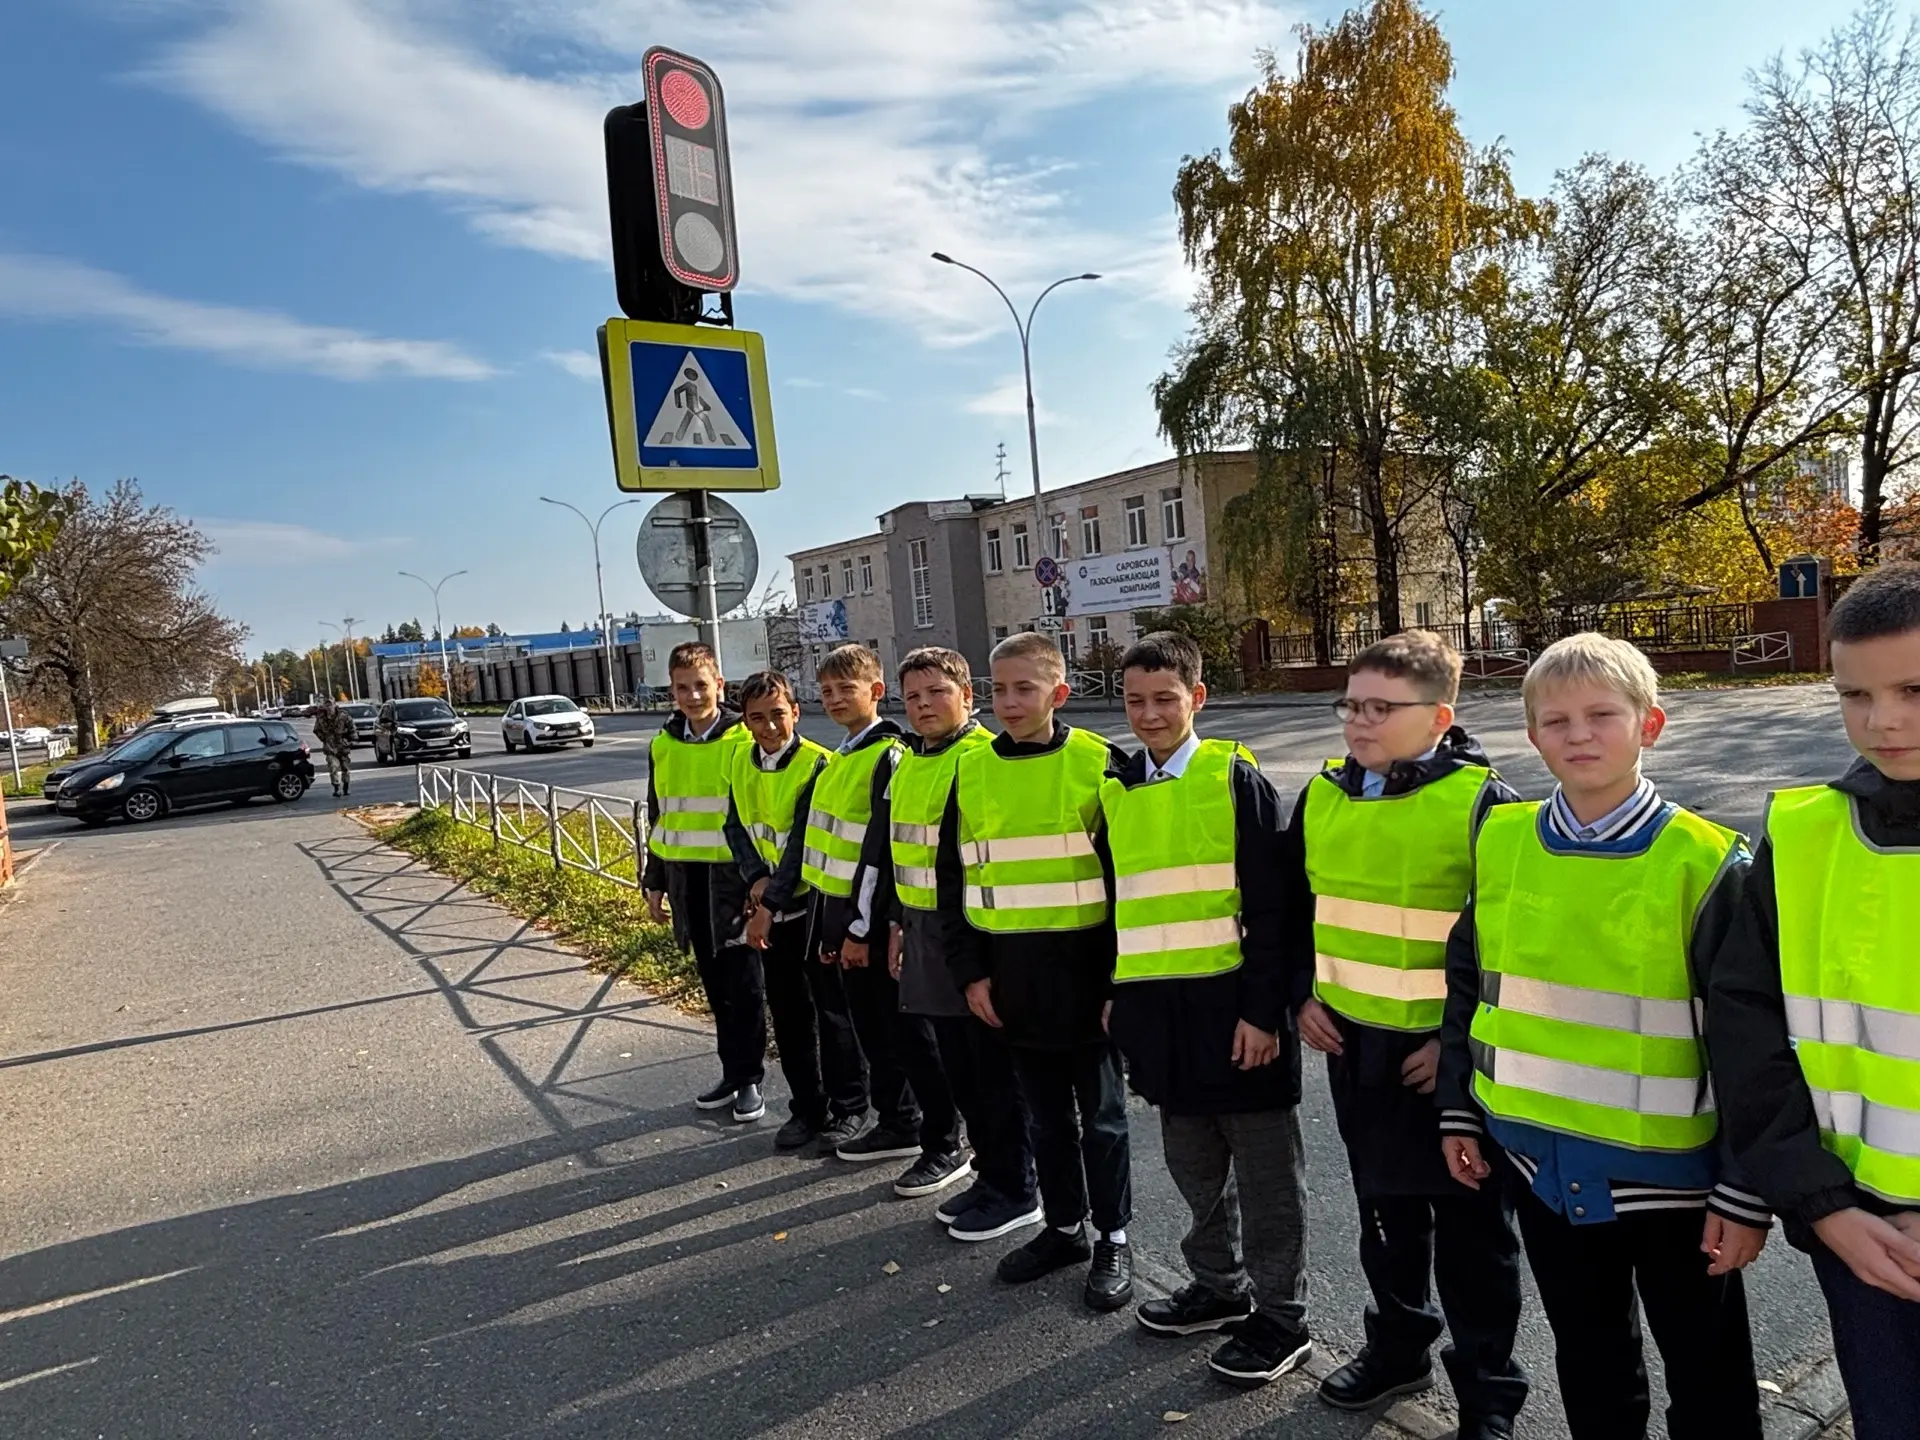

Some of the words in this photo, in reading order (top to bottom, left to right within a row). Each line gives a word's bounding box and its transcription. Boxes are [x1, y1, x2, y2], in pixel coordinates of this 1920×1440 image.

[1116, 557, 1159, 571] САРОВСКАЯ
[1090, 569, 1159, 586] ГАЗОСНАБЖАЮЩАЯ
[1119, 581, 1161, 594] КОМПАНИЯ
